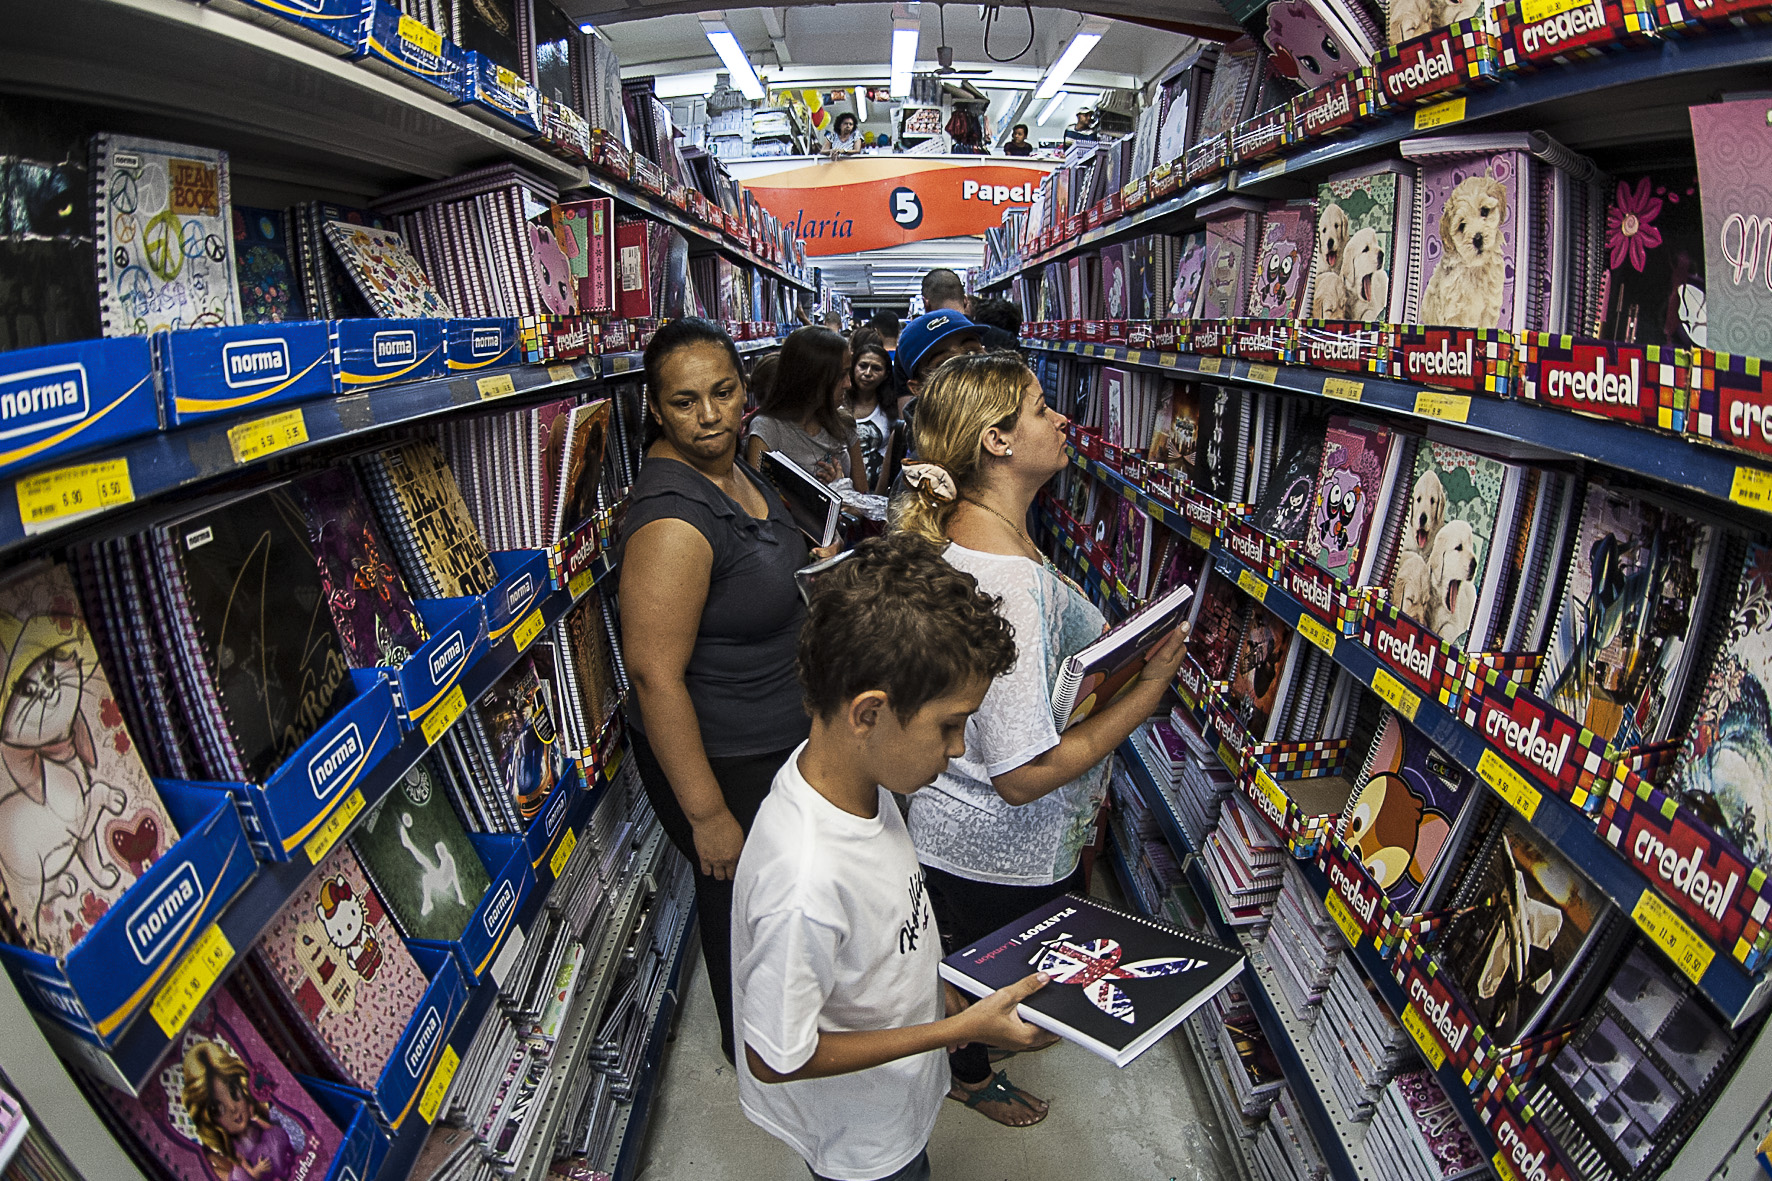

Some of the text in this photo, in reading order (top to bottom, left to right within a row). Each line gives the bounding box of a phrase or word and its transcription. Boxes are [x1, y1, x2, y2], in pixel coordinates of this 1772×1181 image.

[1523, 0, 1607, 53] credeal
[1387, 39, 1454, 96] credeal
[1306, 84, 1350, 130] credeal
[1241, 117, 1275, 155] credeal
[175, 164, 216, 189] JEAN
[174, 187, 215, 209] BOOK
[895, 191, 919, 224] 5
[377, 338, 412, 359] norma
[475, 335, 499, 350] norma
[1155, 325, 1174, 346] credeal
[1195, 325, 1218, 349] credeal
[1240, 325, 1273, 352] credeal
[1311, 329, 1361, 361] credeal
[230, 349, 283, 374] norma
[1408, 338, 1473, 377] credeal
[1, 379, 78, 420] norma
[1548, 356, 1640, 406] credeal
[1186, 500, 1212, 525] credeal
[188, 531, 212, 546] norma
[570, 528, 595, 573] credeal
[1231, 533, 1263, 564] credeal
[509, 581, 531, 606] norma
[1292, 574, 1332, 613] credeal
[433, 640, 461, 675] norma
[1377, 629, 1436, 681] credeal
[1215, 714, 1244, 754] credeal
[1485, 703, 1571, 778] credeal
[315, 735, 358, 786] norma
[547, 798, 565, 829] norma
[1330, 864, 1378, 925] credeal
[1634, 829, 1740, 923] credeal
[136, 876, 194, 949] norma
[486, 888, 511, 928] norma
[974, 907, 1077, 965] PLAYBOY London
[1410, 978, 1469, 1053] credeal
[409, 1016, 437, 1067] norma
